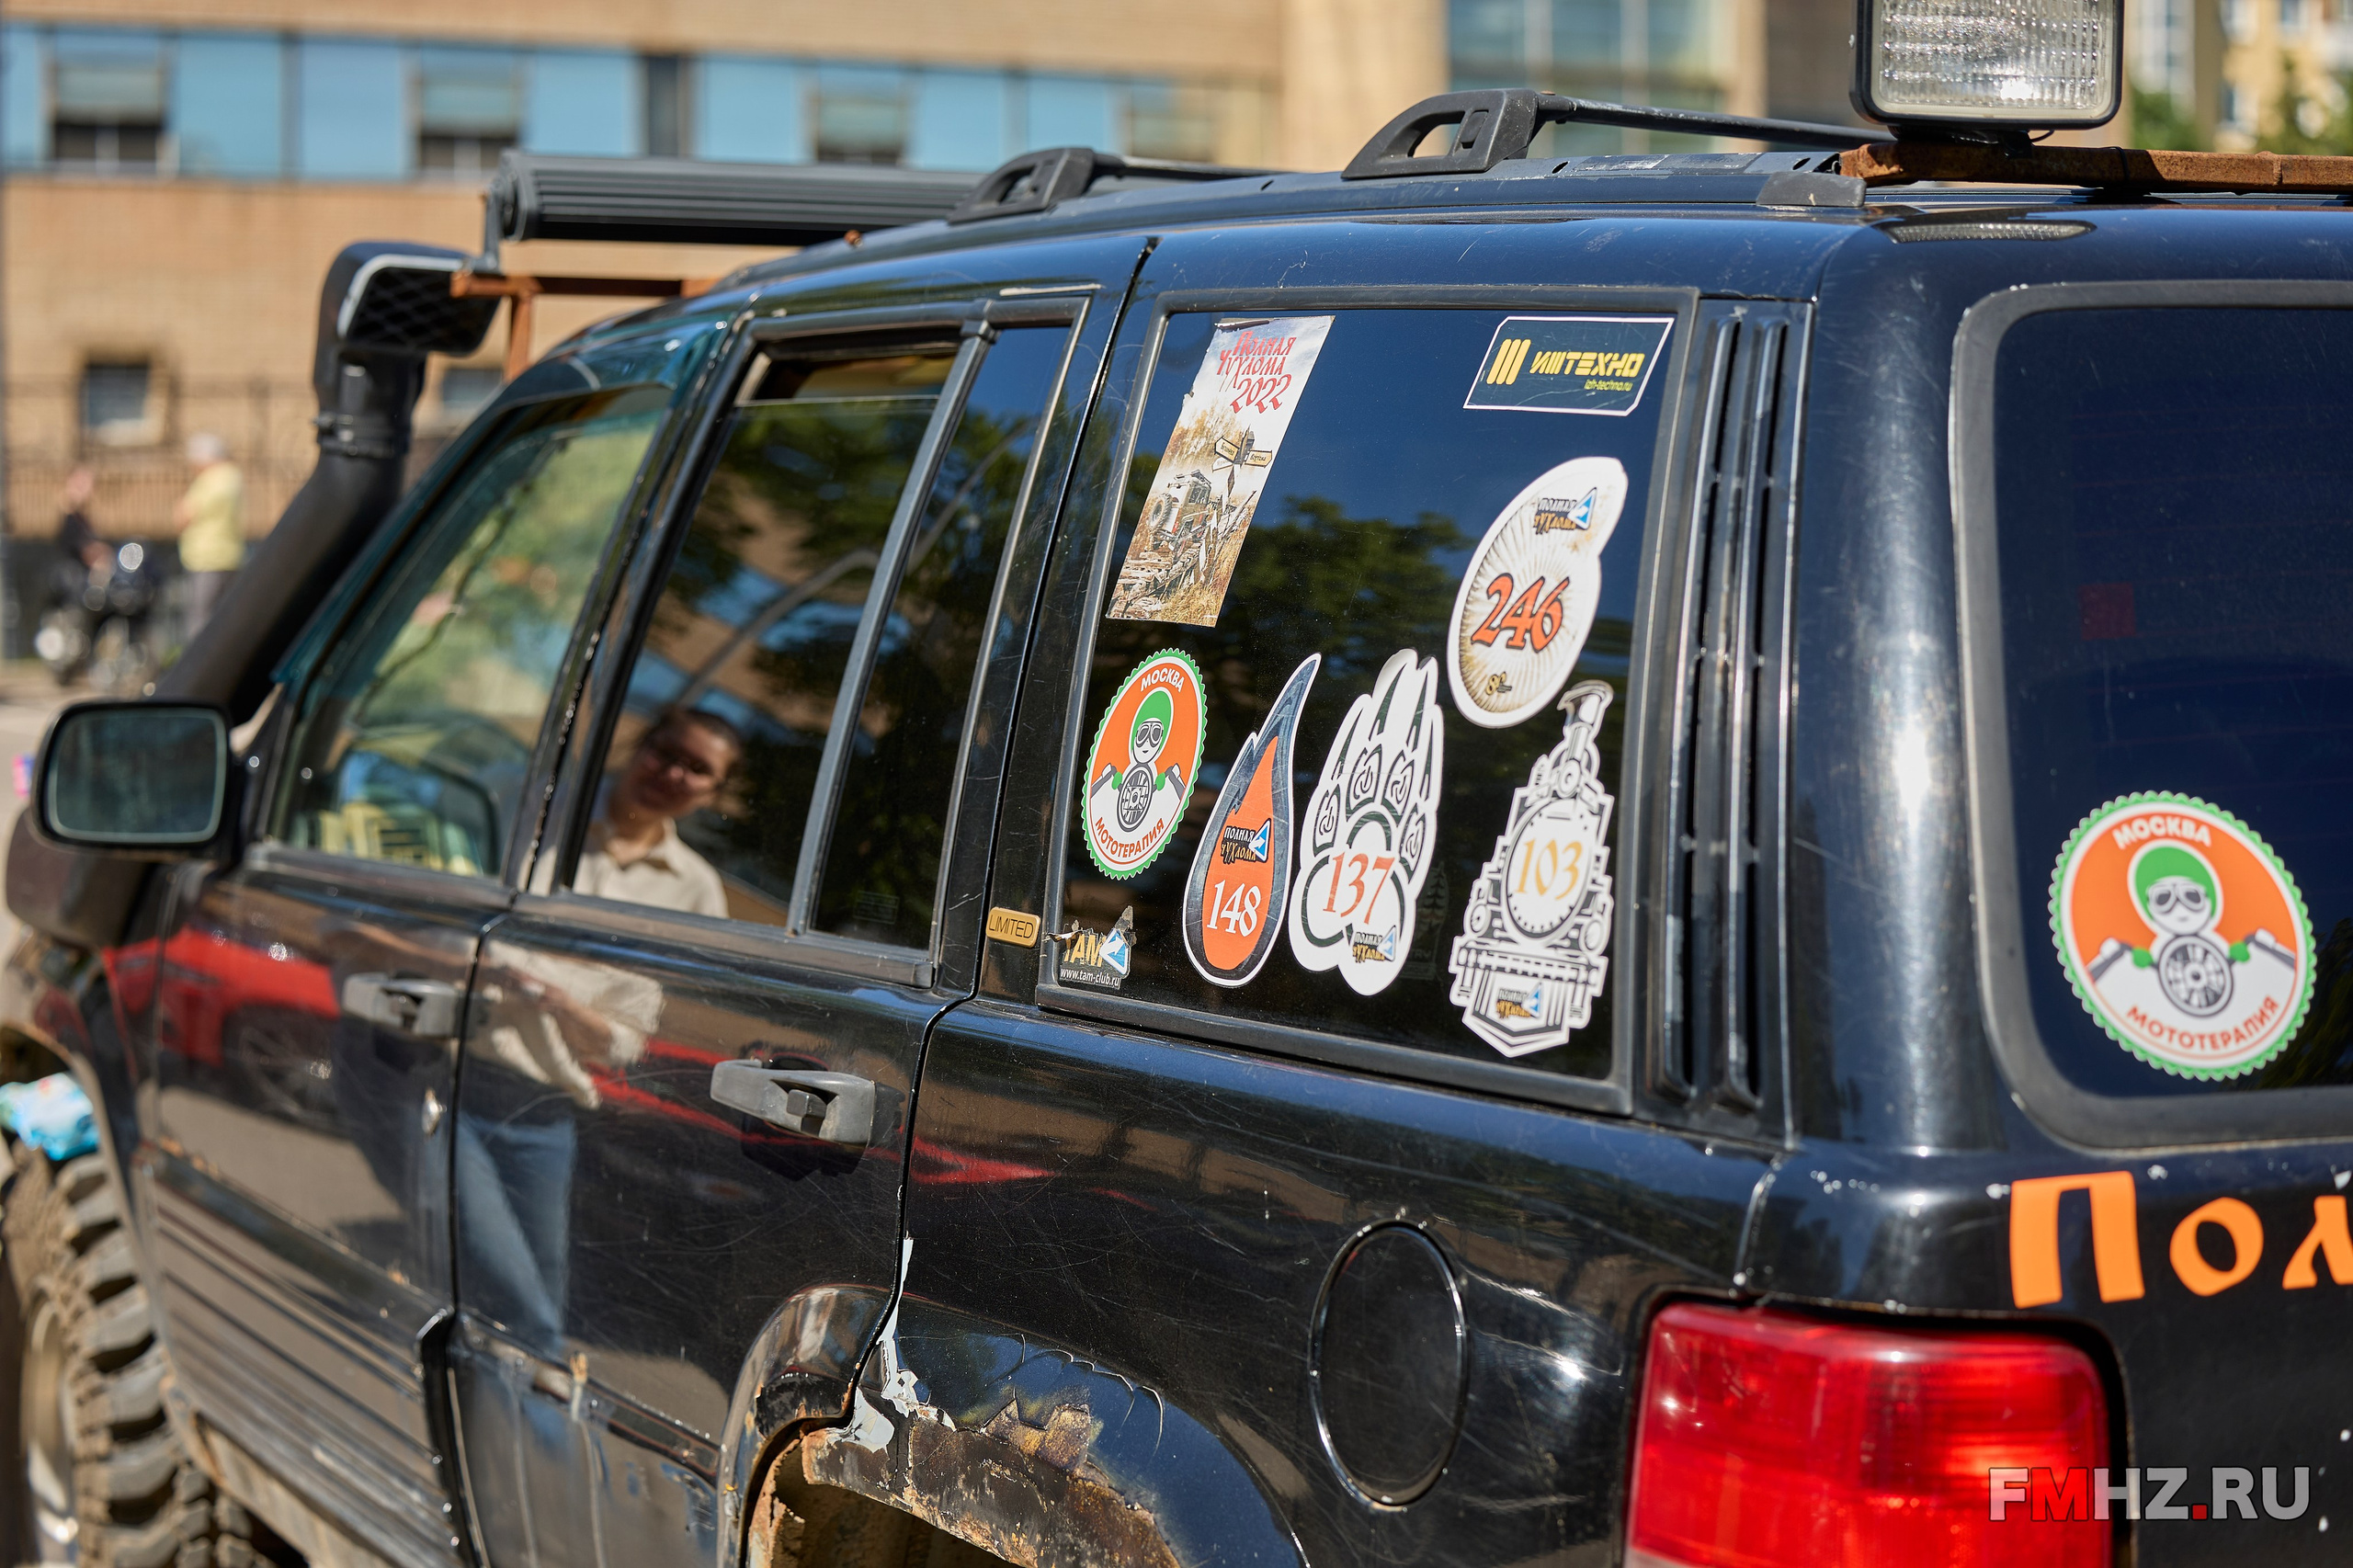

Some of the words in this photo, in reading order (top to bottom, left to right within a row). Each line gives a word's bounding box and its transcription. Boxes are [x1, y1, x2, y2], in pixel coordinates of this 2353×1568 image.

[1230, 373, 1292, 414] 2022
[1471, 573, 1569, 653] 246
[1140, 667, 1185, 693] МОСКВА
[1095, 816, 1165, 858] МОТОТЕРАПИЯ
[2112, 816, 2211, 850] МОСКВА
[1322, 851, 1395, 926] 137
[1514, 838, 1584, 902] 103
[988, 915, 1034, 939] LIMITED
[1206, 880, 1261, 937] 148
[1060, 967, 1120, 987] www.tam-club.ru
[2125, 995, 2280, 1051] МОТОТЕРАПИЯ
